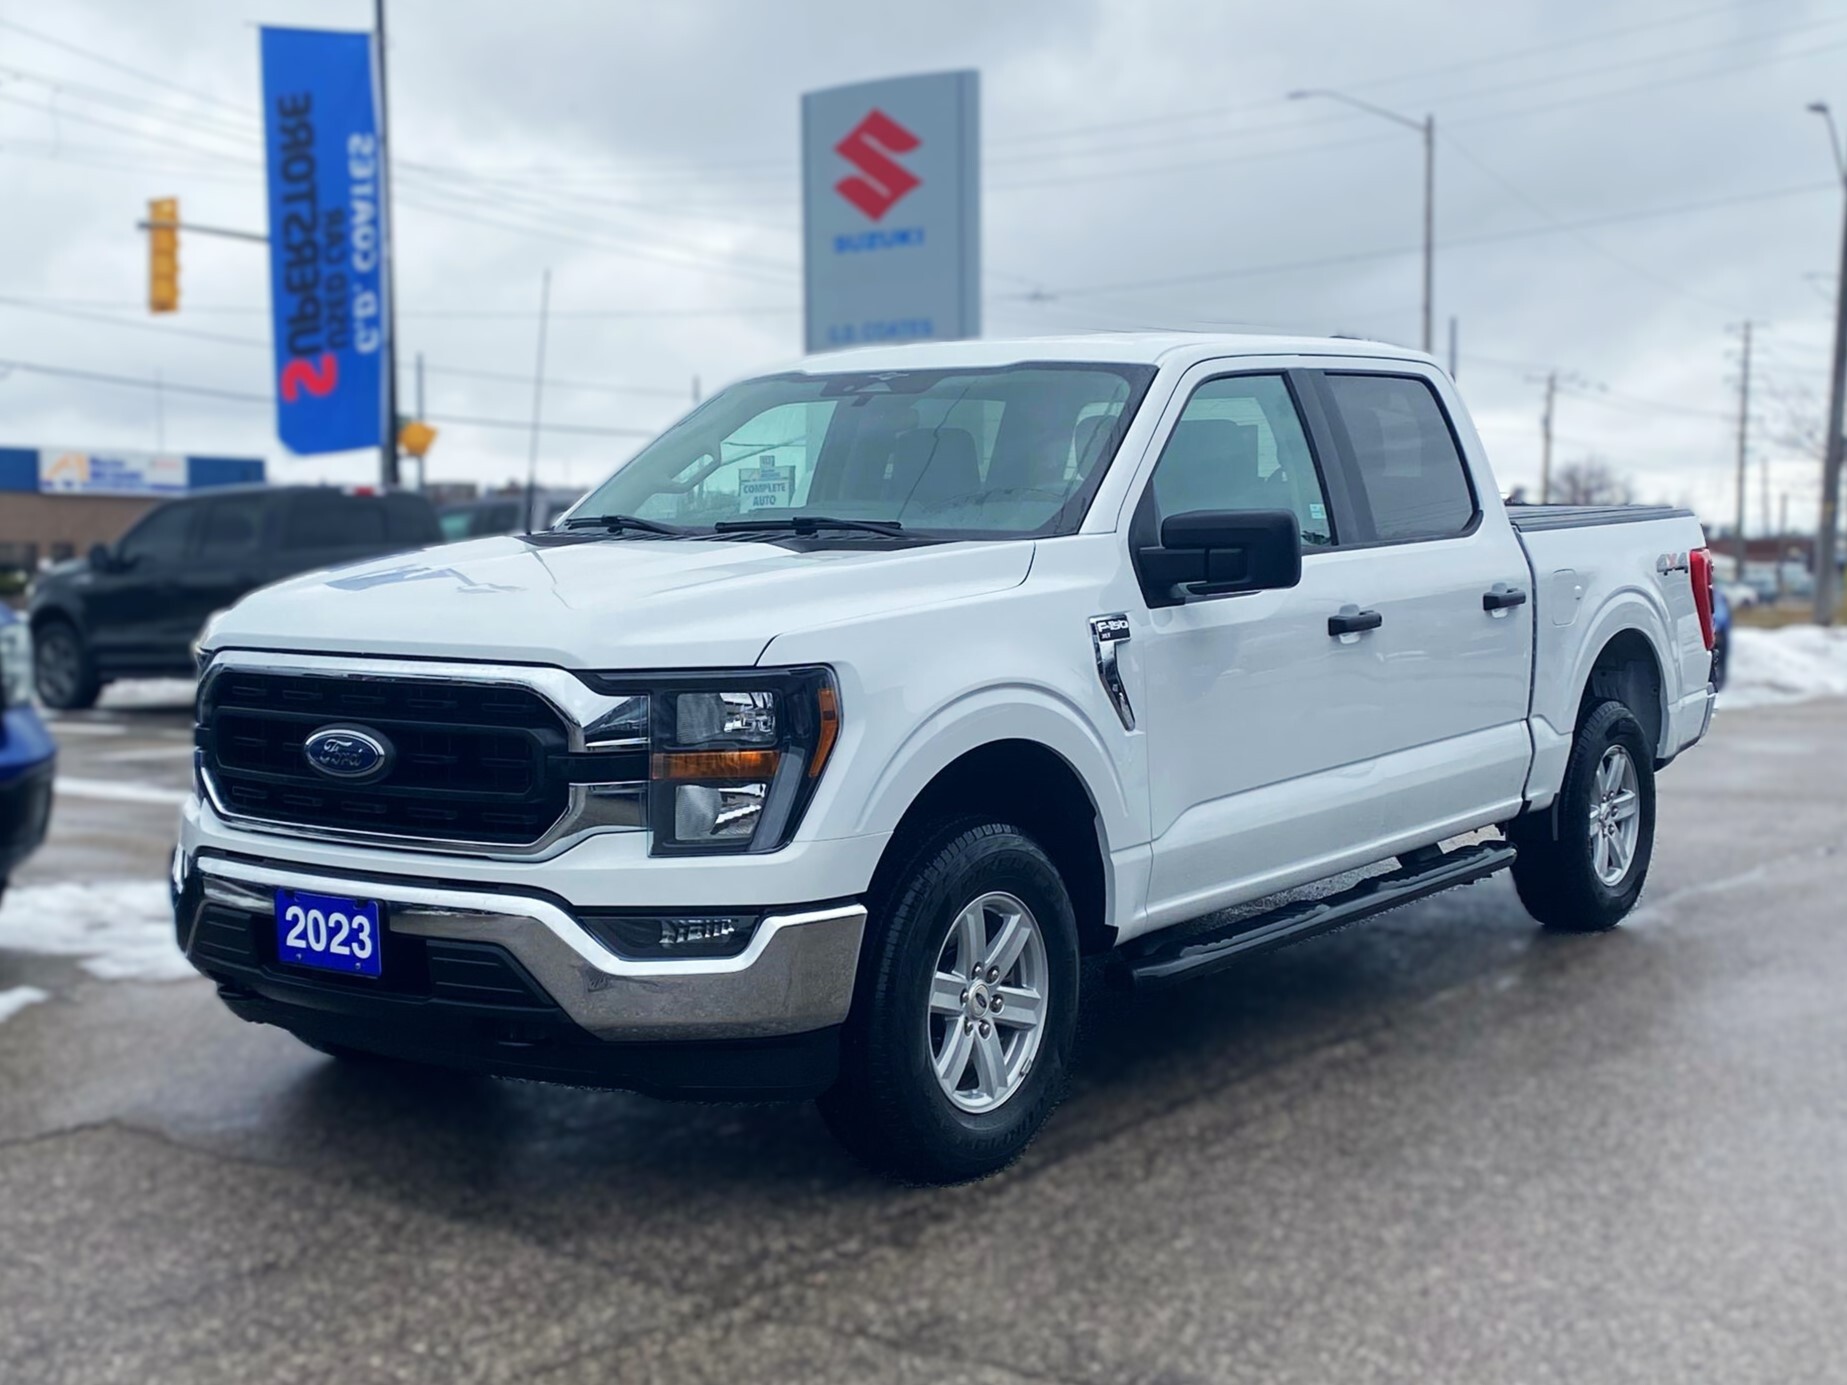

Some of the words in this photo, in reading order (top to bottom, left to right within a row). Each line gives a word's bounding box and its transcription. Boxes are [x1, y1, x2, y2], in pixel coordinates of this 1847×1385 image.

[834, 228, 925, 254] SUZUKI
[743, 483, 786, 494] COMPLETE
[753, 495, 776, 506] AUTO
[1097, 620, 1128, 632] F-150
[319, 738, 363, 767] Ford
[285, 906, 372, 959] 2023
